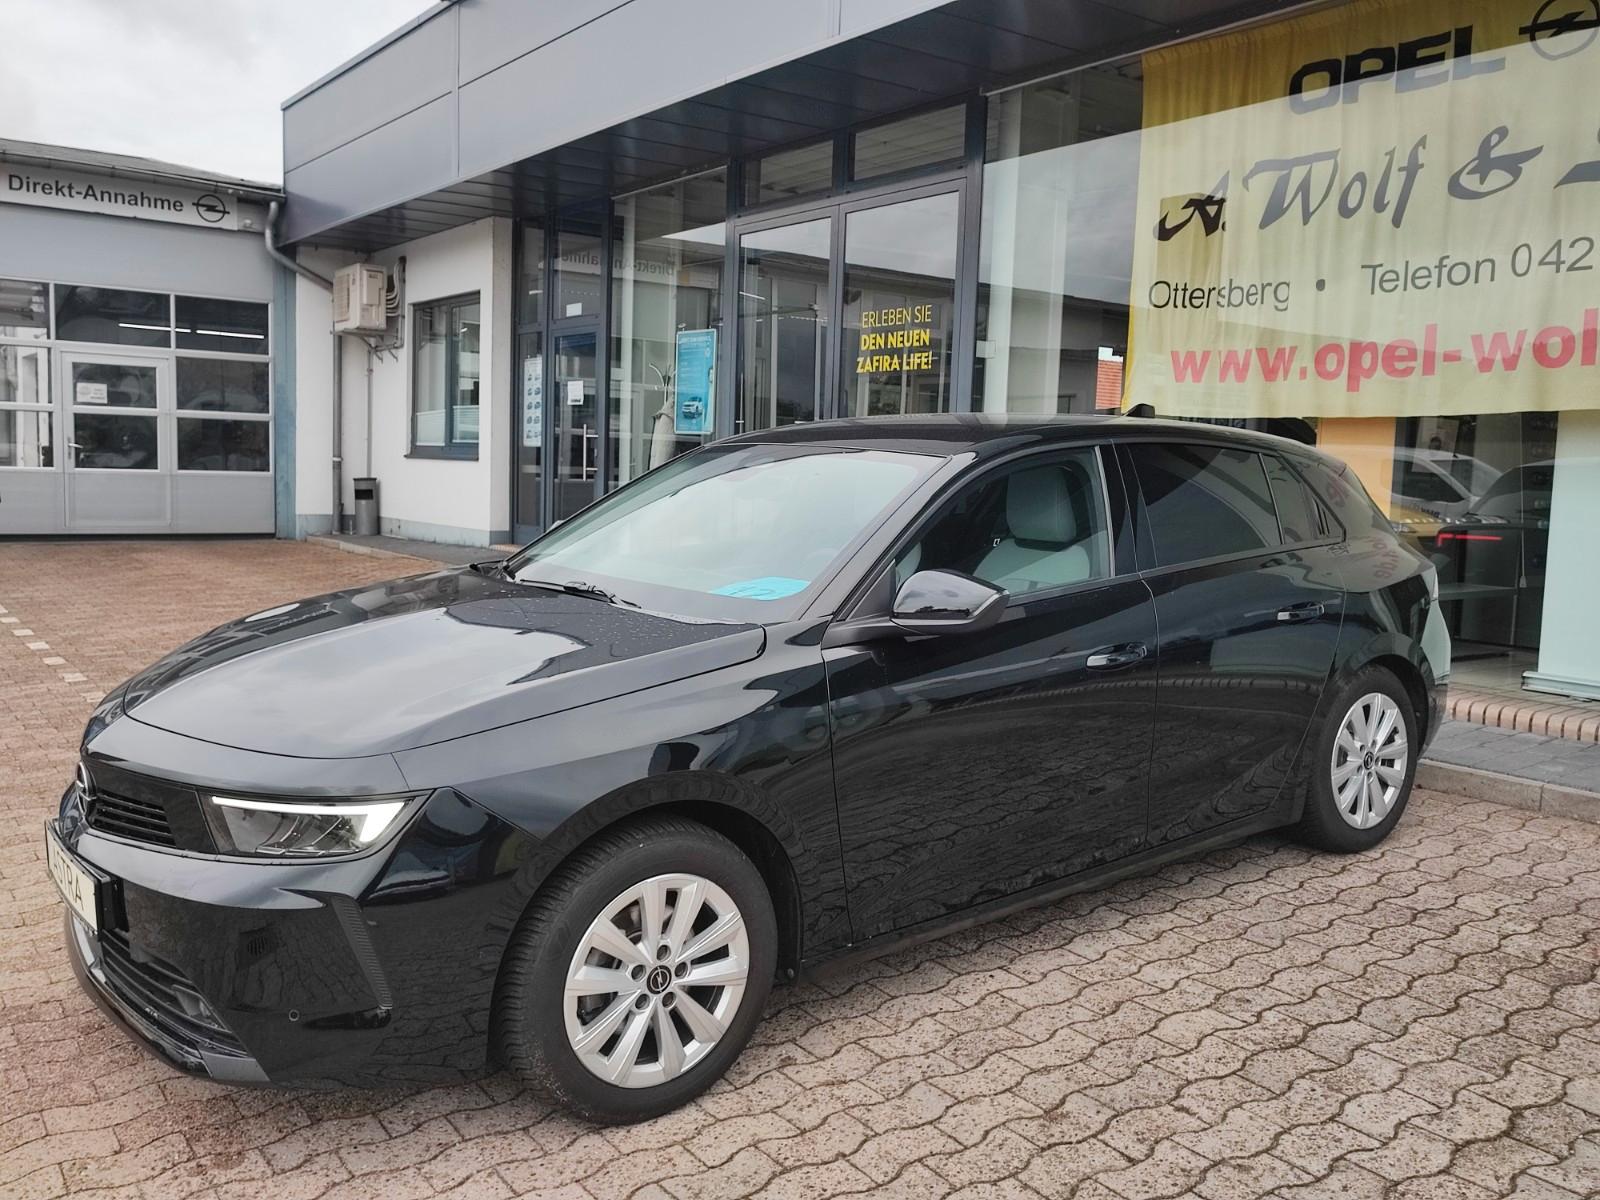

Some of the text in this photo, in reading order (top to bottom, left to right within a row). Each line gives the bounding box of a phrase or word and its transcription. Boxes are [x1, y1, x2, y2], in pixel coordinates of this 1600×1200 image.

[1289, 25, 1505, 115] OPEL
[8, 173, 184, 212] Direkt-Annahme
[1242, 135, 1427, 230] Wolf
[1448, 125, 1544, 201] &
[1148, 236, 1594, 312] Ottersberg Telefon 042
[862, 305, 932, 329] ERLEBEN SIE
[861, 329, 930, 351] DEN NEUEN
[856, 351, 932, 373] ZAFIRA LIFE!
